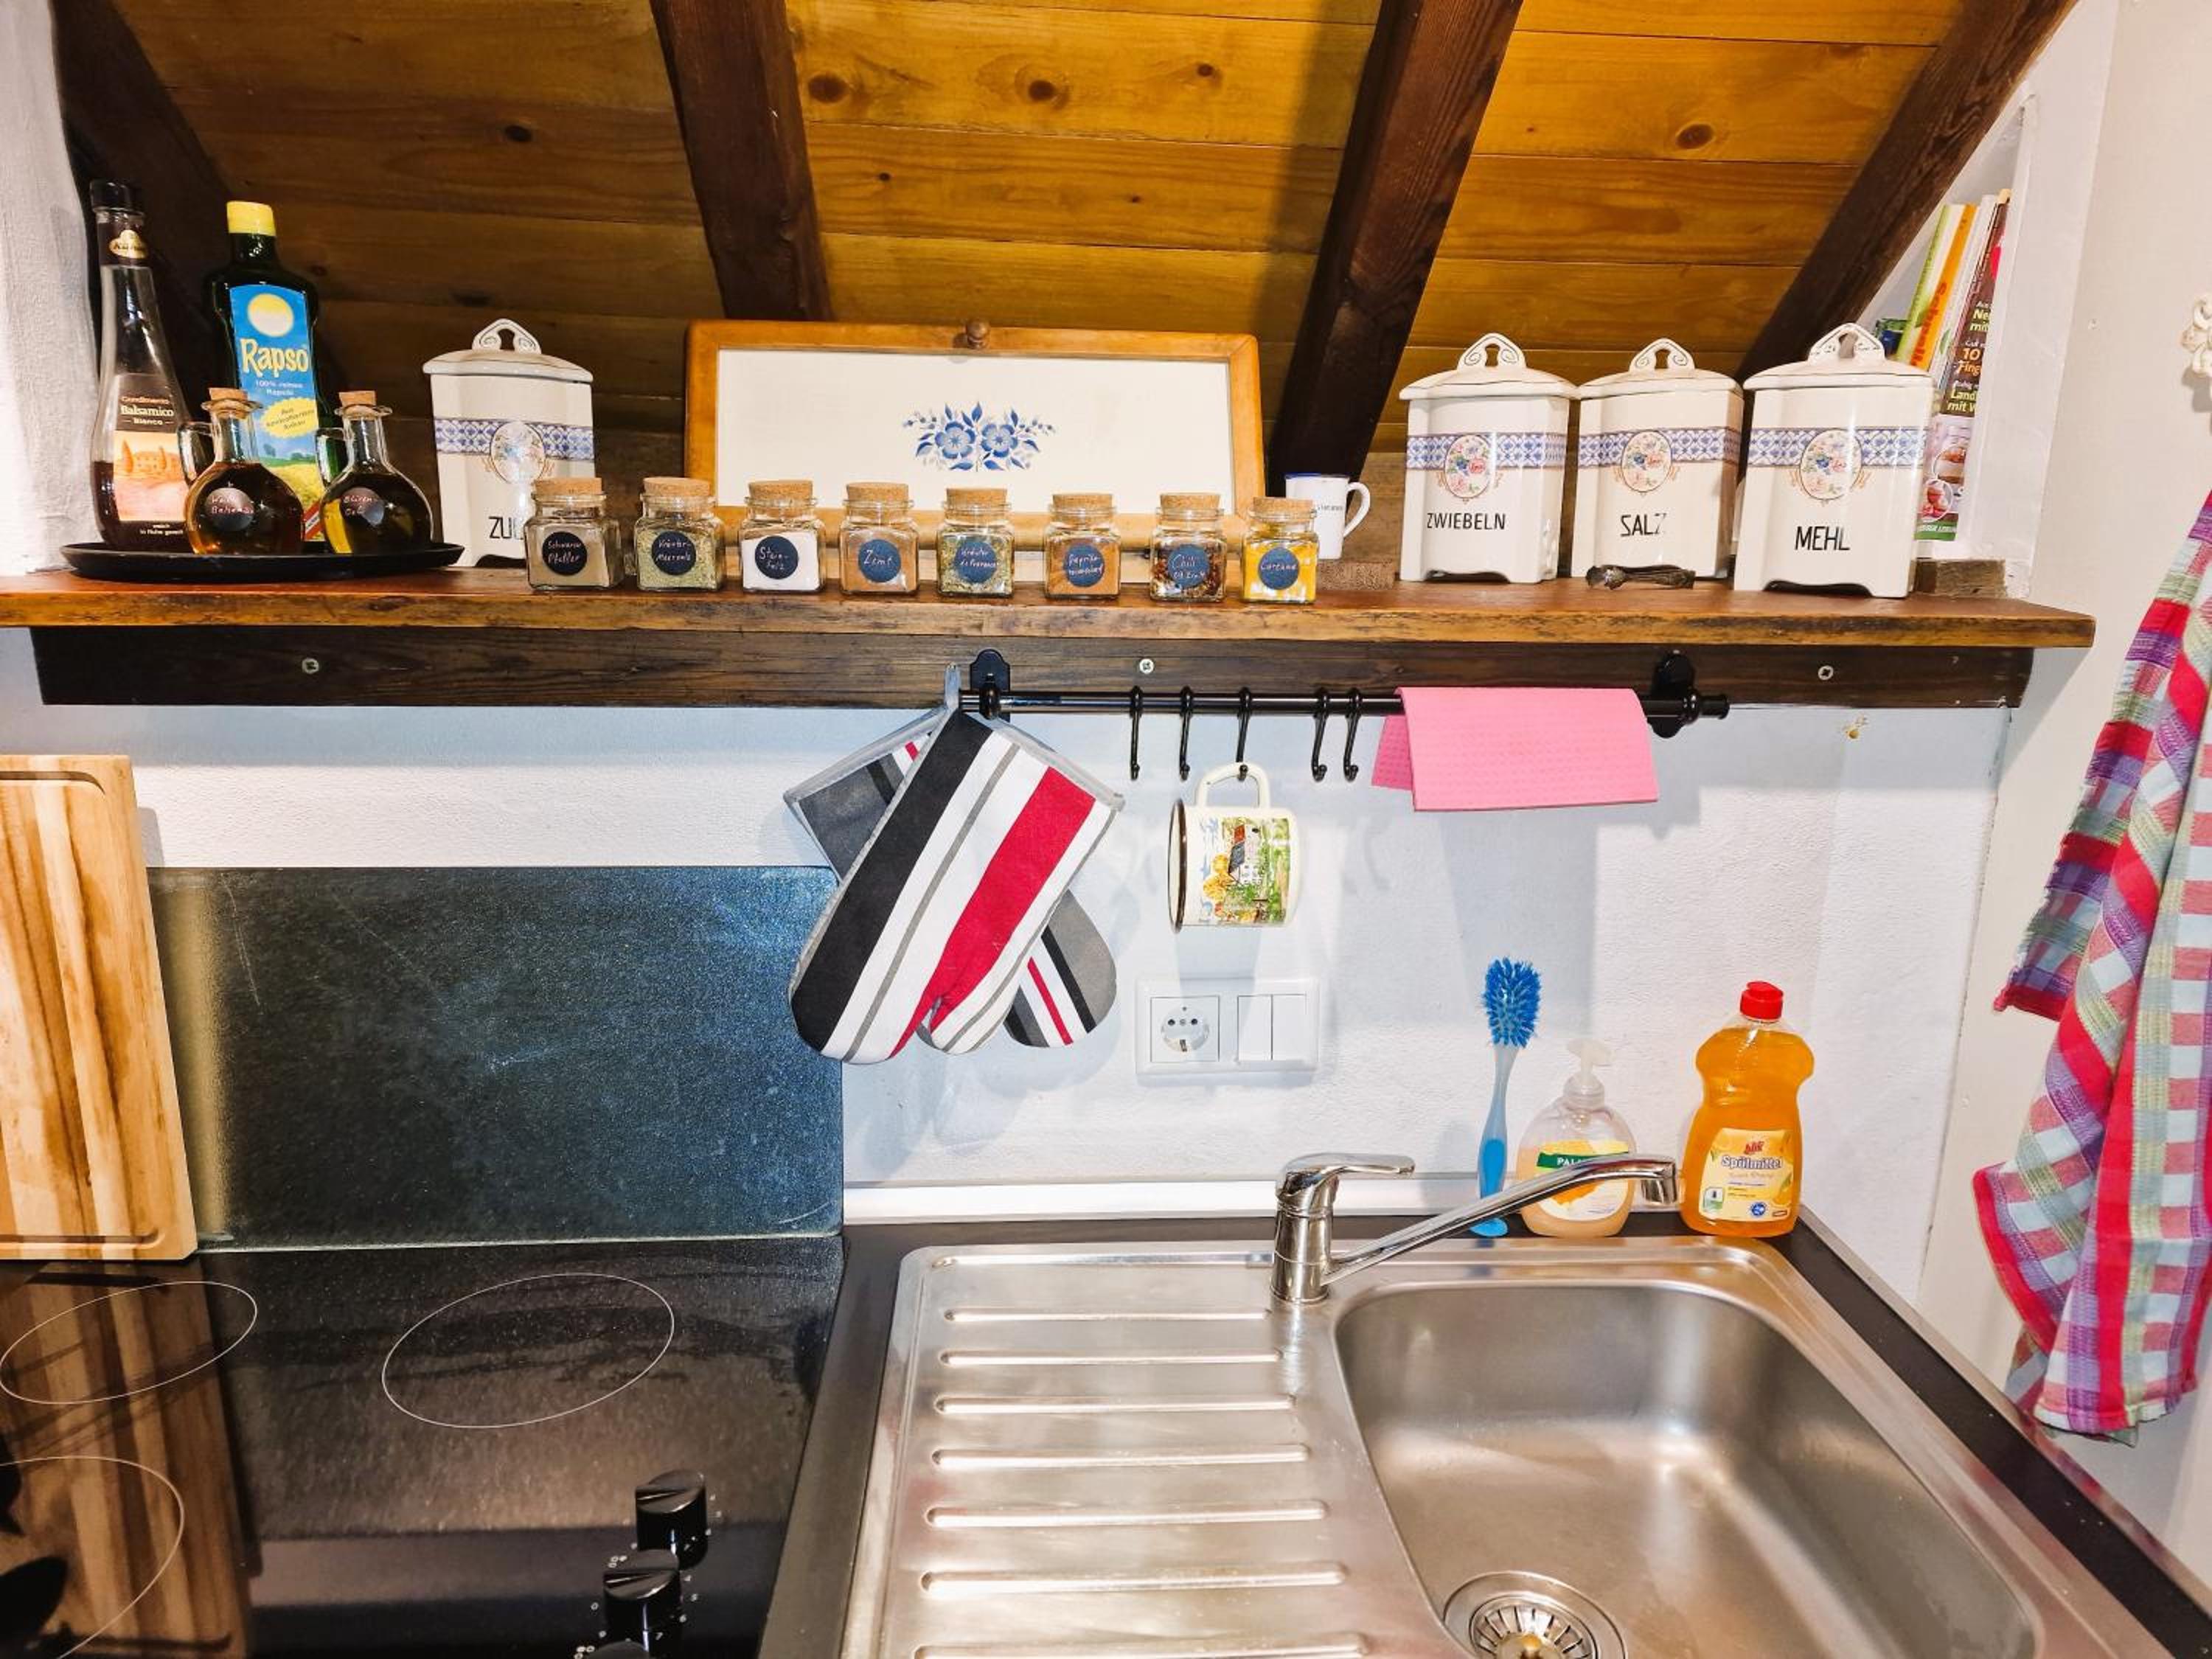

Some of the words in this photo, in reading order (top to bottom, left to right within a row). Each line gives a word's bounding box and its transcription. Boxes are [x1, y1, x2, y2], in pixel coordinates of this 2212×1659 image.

[240, 338, 309, 378] Rapso
[1963, 348, 1980, 361] 10
[120, 404, 175, 417] Balsamico
[133, 417, 163, 425] Bianco
[1427, 512, 1506, 530] ZWIEBELN
[1620, 512, 1666, 537] SALZ
[1795, 526, 1850, 551] MEHL
[1557, 1157, 1583, 1166] PAL
[1722, 1155, 1782, 1169] Spülmittel
